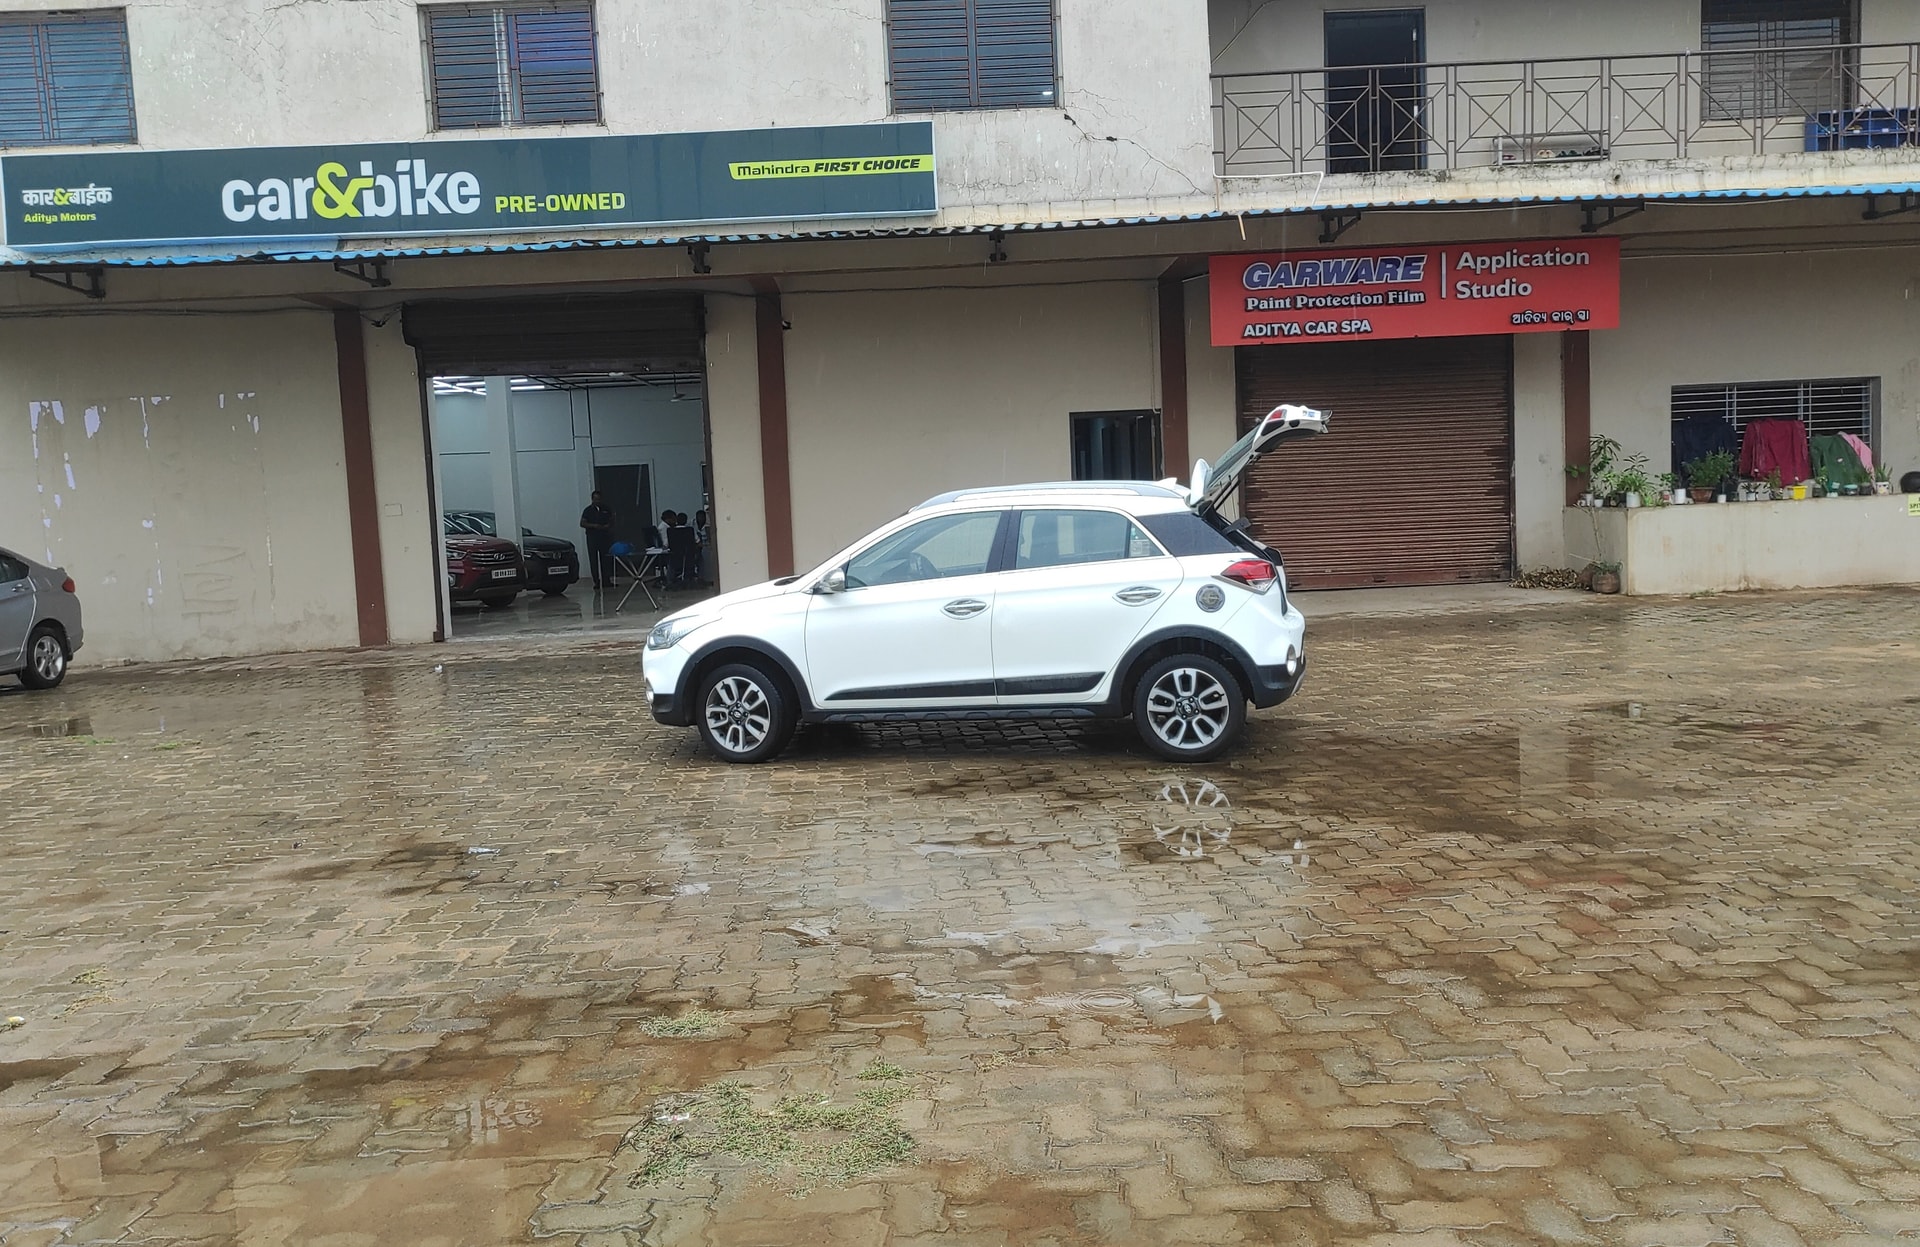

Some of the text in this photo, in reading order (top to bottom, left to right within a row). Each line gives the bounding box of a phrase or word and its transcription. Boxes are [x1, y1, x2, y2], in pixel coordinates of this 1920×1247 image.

[737, 158, 920, 176] Mahindra FIRST CHOICE
[221, 159, 481, 222] car&bike
[495, 192, 626, 213] PRE-OWNED
[24, 212, 97, 224] Aditya Motors
[1456, 247, 1589, 274] Application
[1243, 255, 1427, 290] GARWARE
[1456, 278, 1532, 299] Studio
[1246, 290, 1425, 311] Paint Protection Film
[1243, 319, 1372, 337] ADITYA CAR SPA
